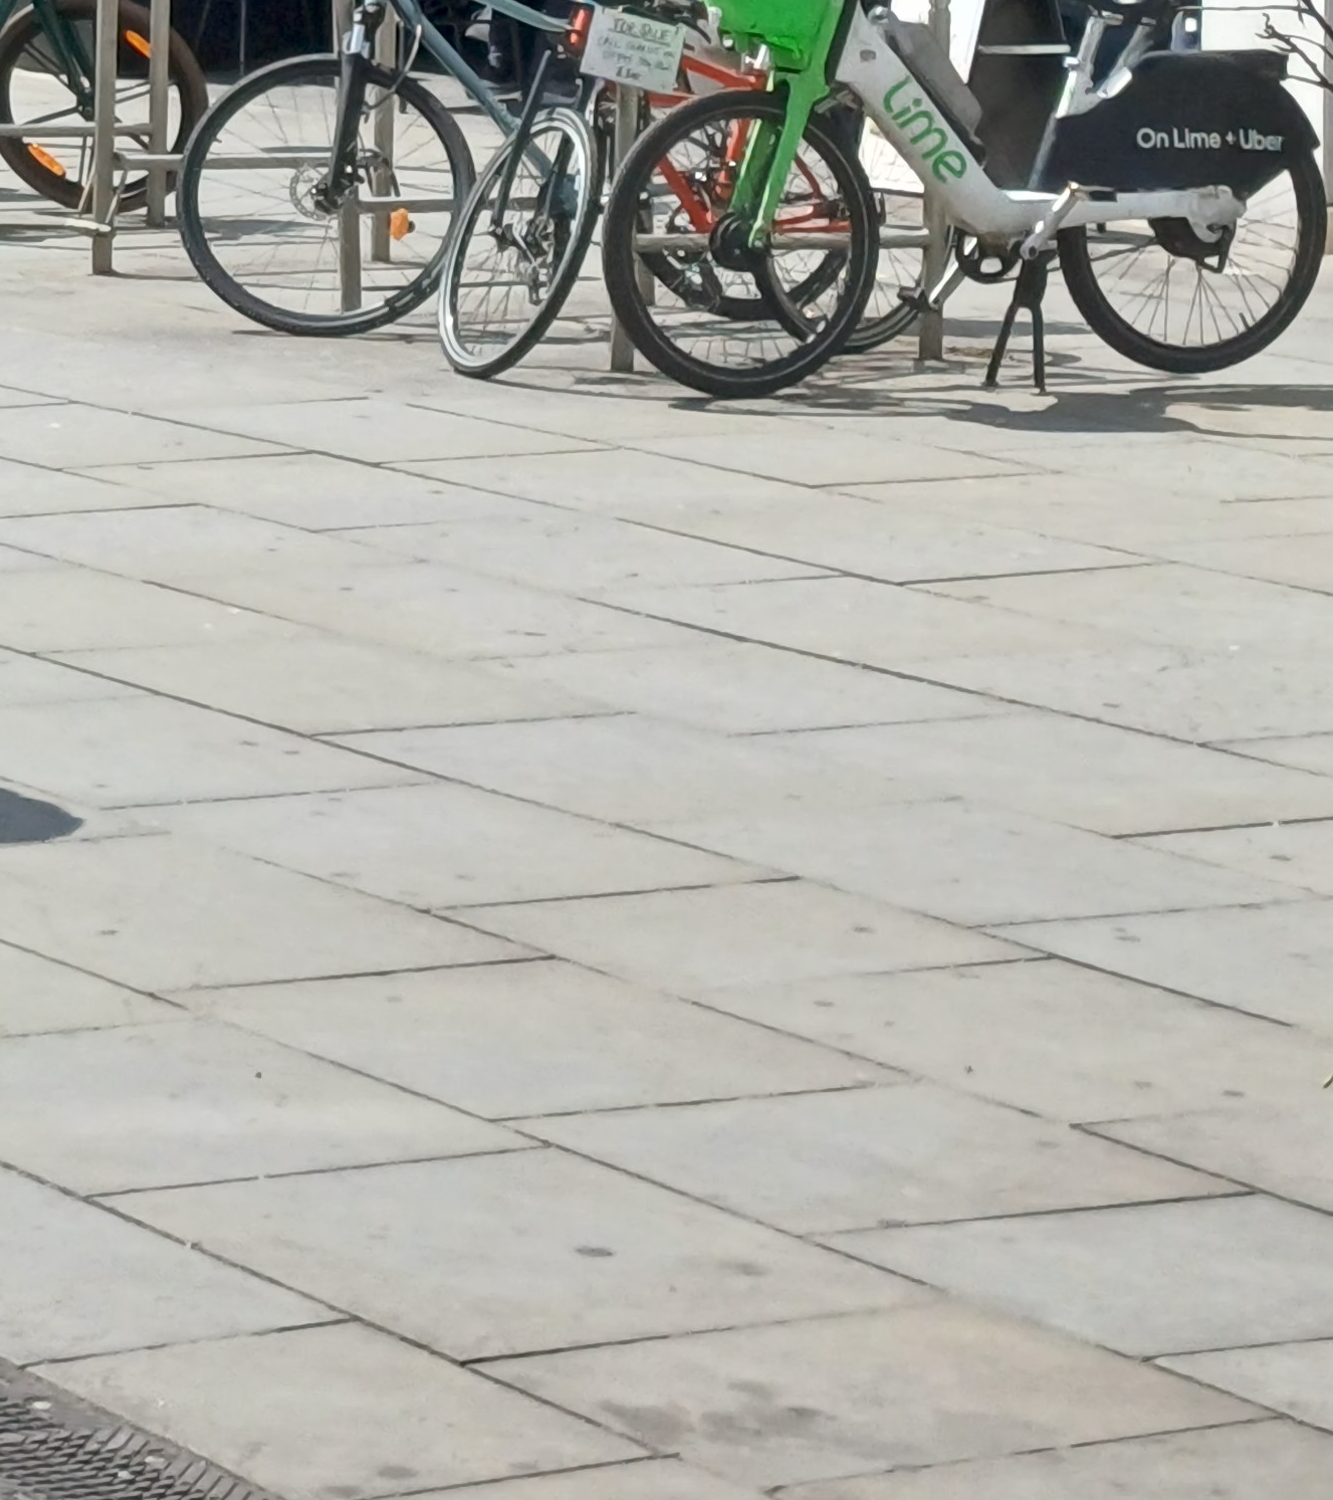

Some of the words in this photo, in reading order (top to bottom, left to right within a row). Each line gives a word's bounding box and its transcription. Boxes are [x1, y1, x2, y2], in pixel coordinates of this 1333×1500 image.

[883, 73, 967, 183] Lime
[1136, 127, 1169, 149] On
[1173, 126, 1222, 149] Lime
[1238, 128, 1285, 151] Uber
